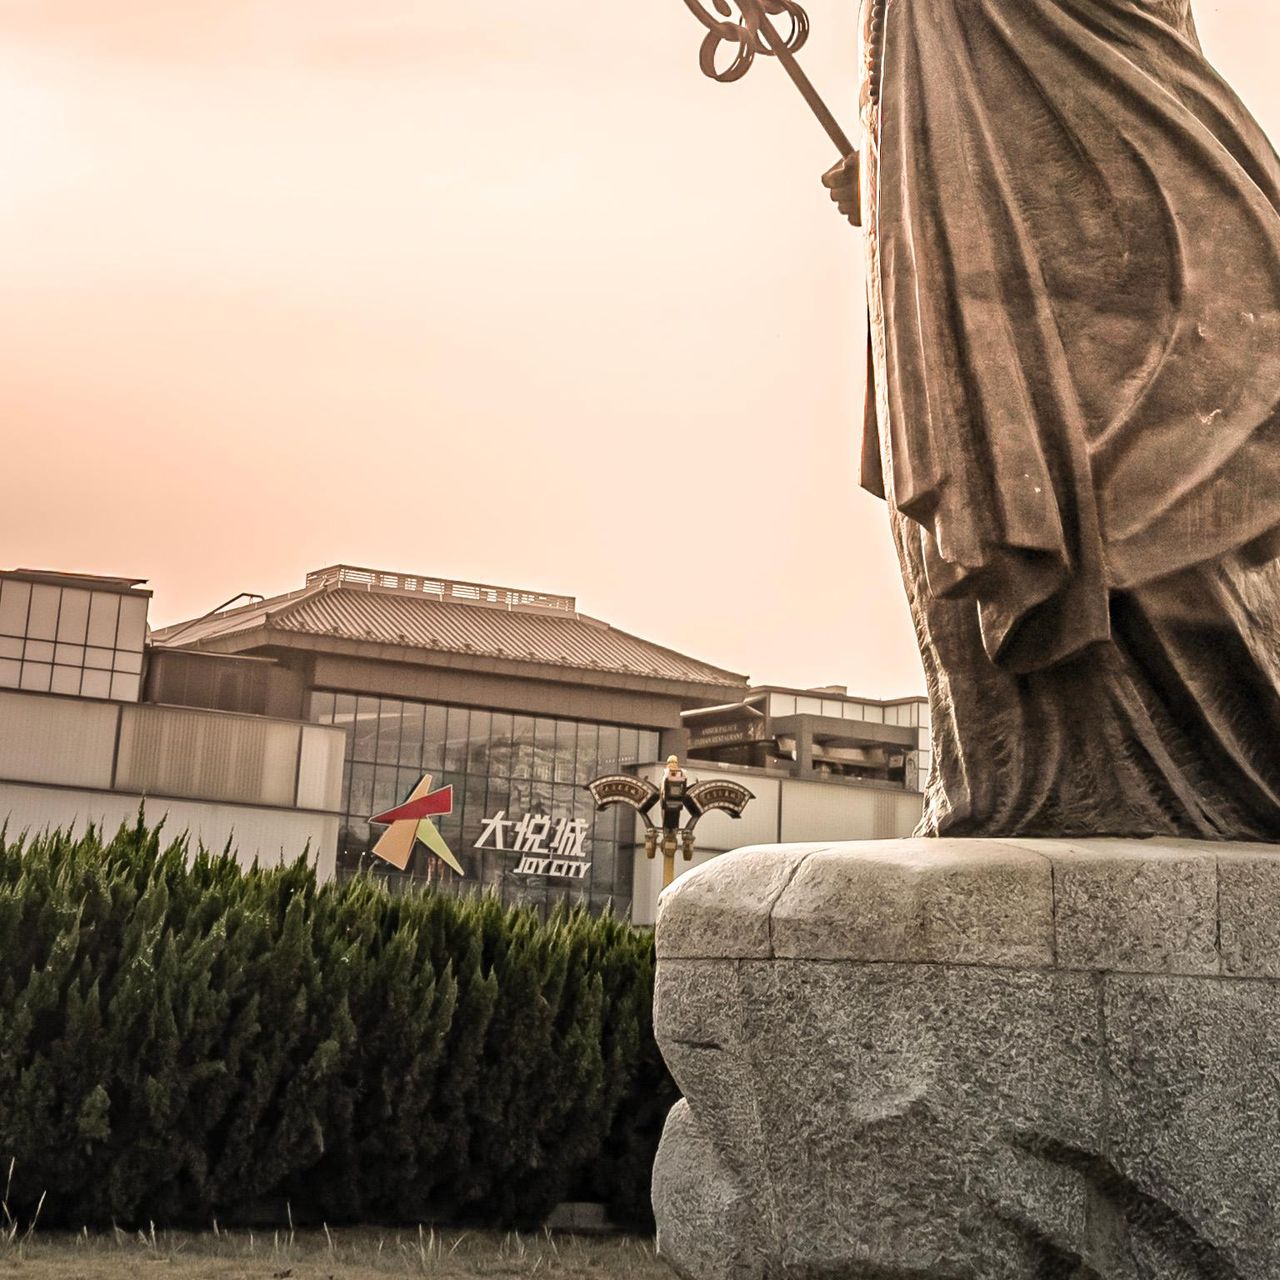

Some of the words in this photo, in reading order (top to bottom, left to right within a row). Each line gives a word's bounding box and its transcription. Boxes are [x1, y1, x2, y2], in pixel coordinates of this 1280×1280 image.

[473, 810, 589, 857] 大悦城
[513, 857, 547, 875] JOY
[549, 859, 592, 879] CITY
